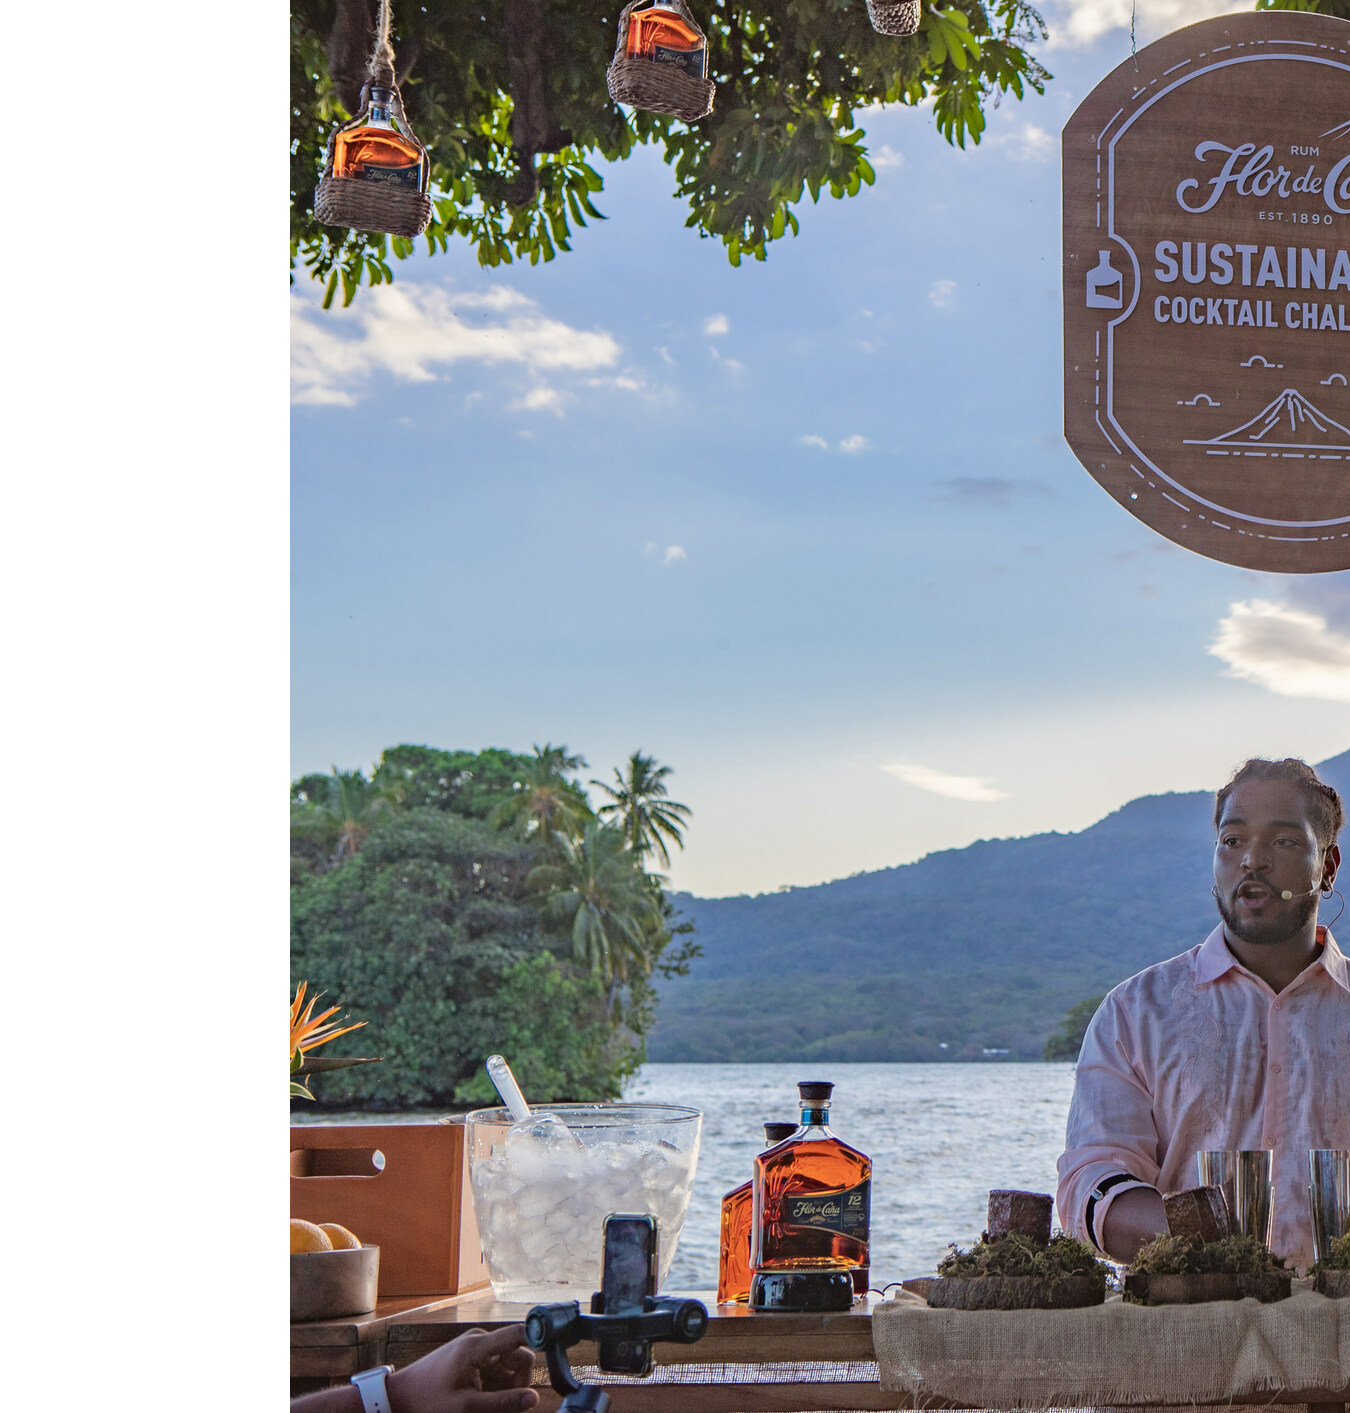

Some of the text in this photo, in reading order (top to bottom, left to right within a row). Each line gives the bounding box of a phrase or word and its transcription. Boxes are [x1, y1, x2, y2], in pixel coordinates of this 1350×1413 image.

[1290, 145, 1320, 157] RUM
[1176, 140, 1291, 213] Flor
[1292, 165, 1323, 194] de
[1154, 295, 1279, 328] COCKTAIL
[848, 1195, 862, 1206] 12
[793, 1201, 815, 1218] Flor
[821, 1201, 841, 1217] Caña
